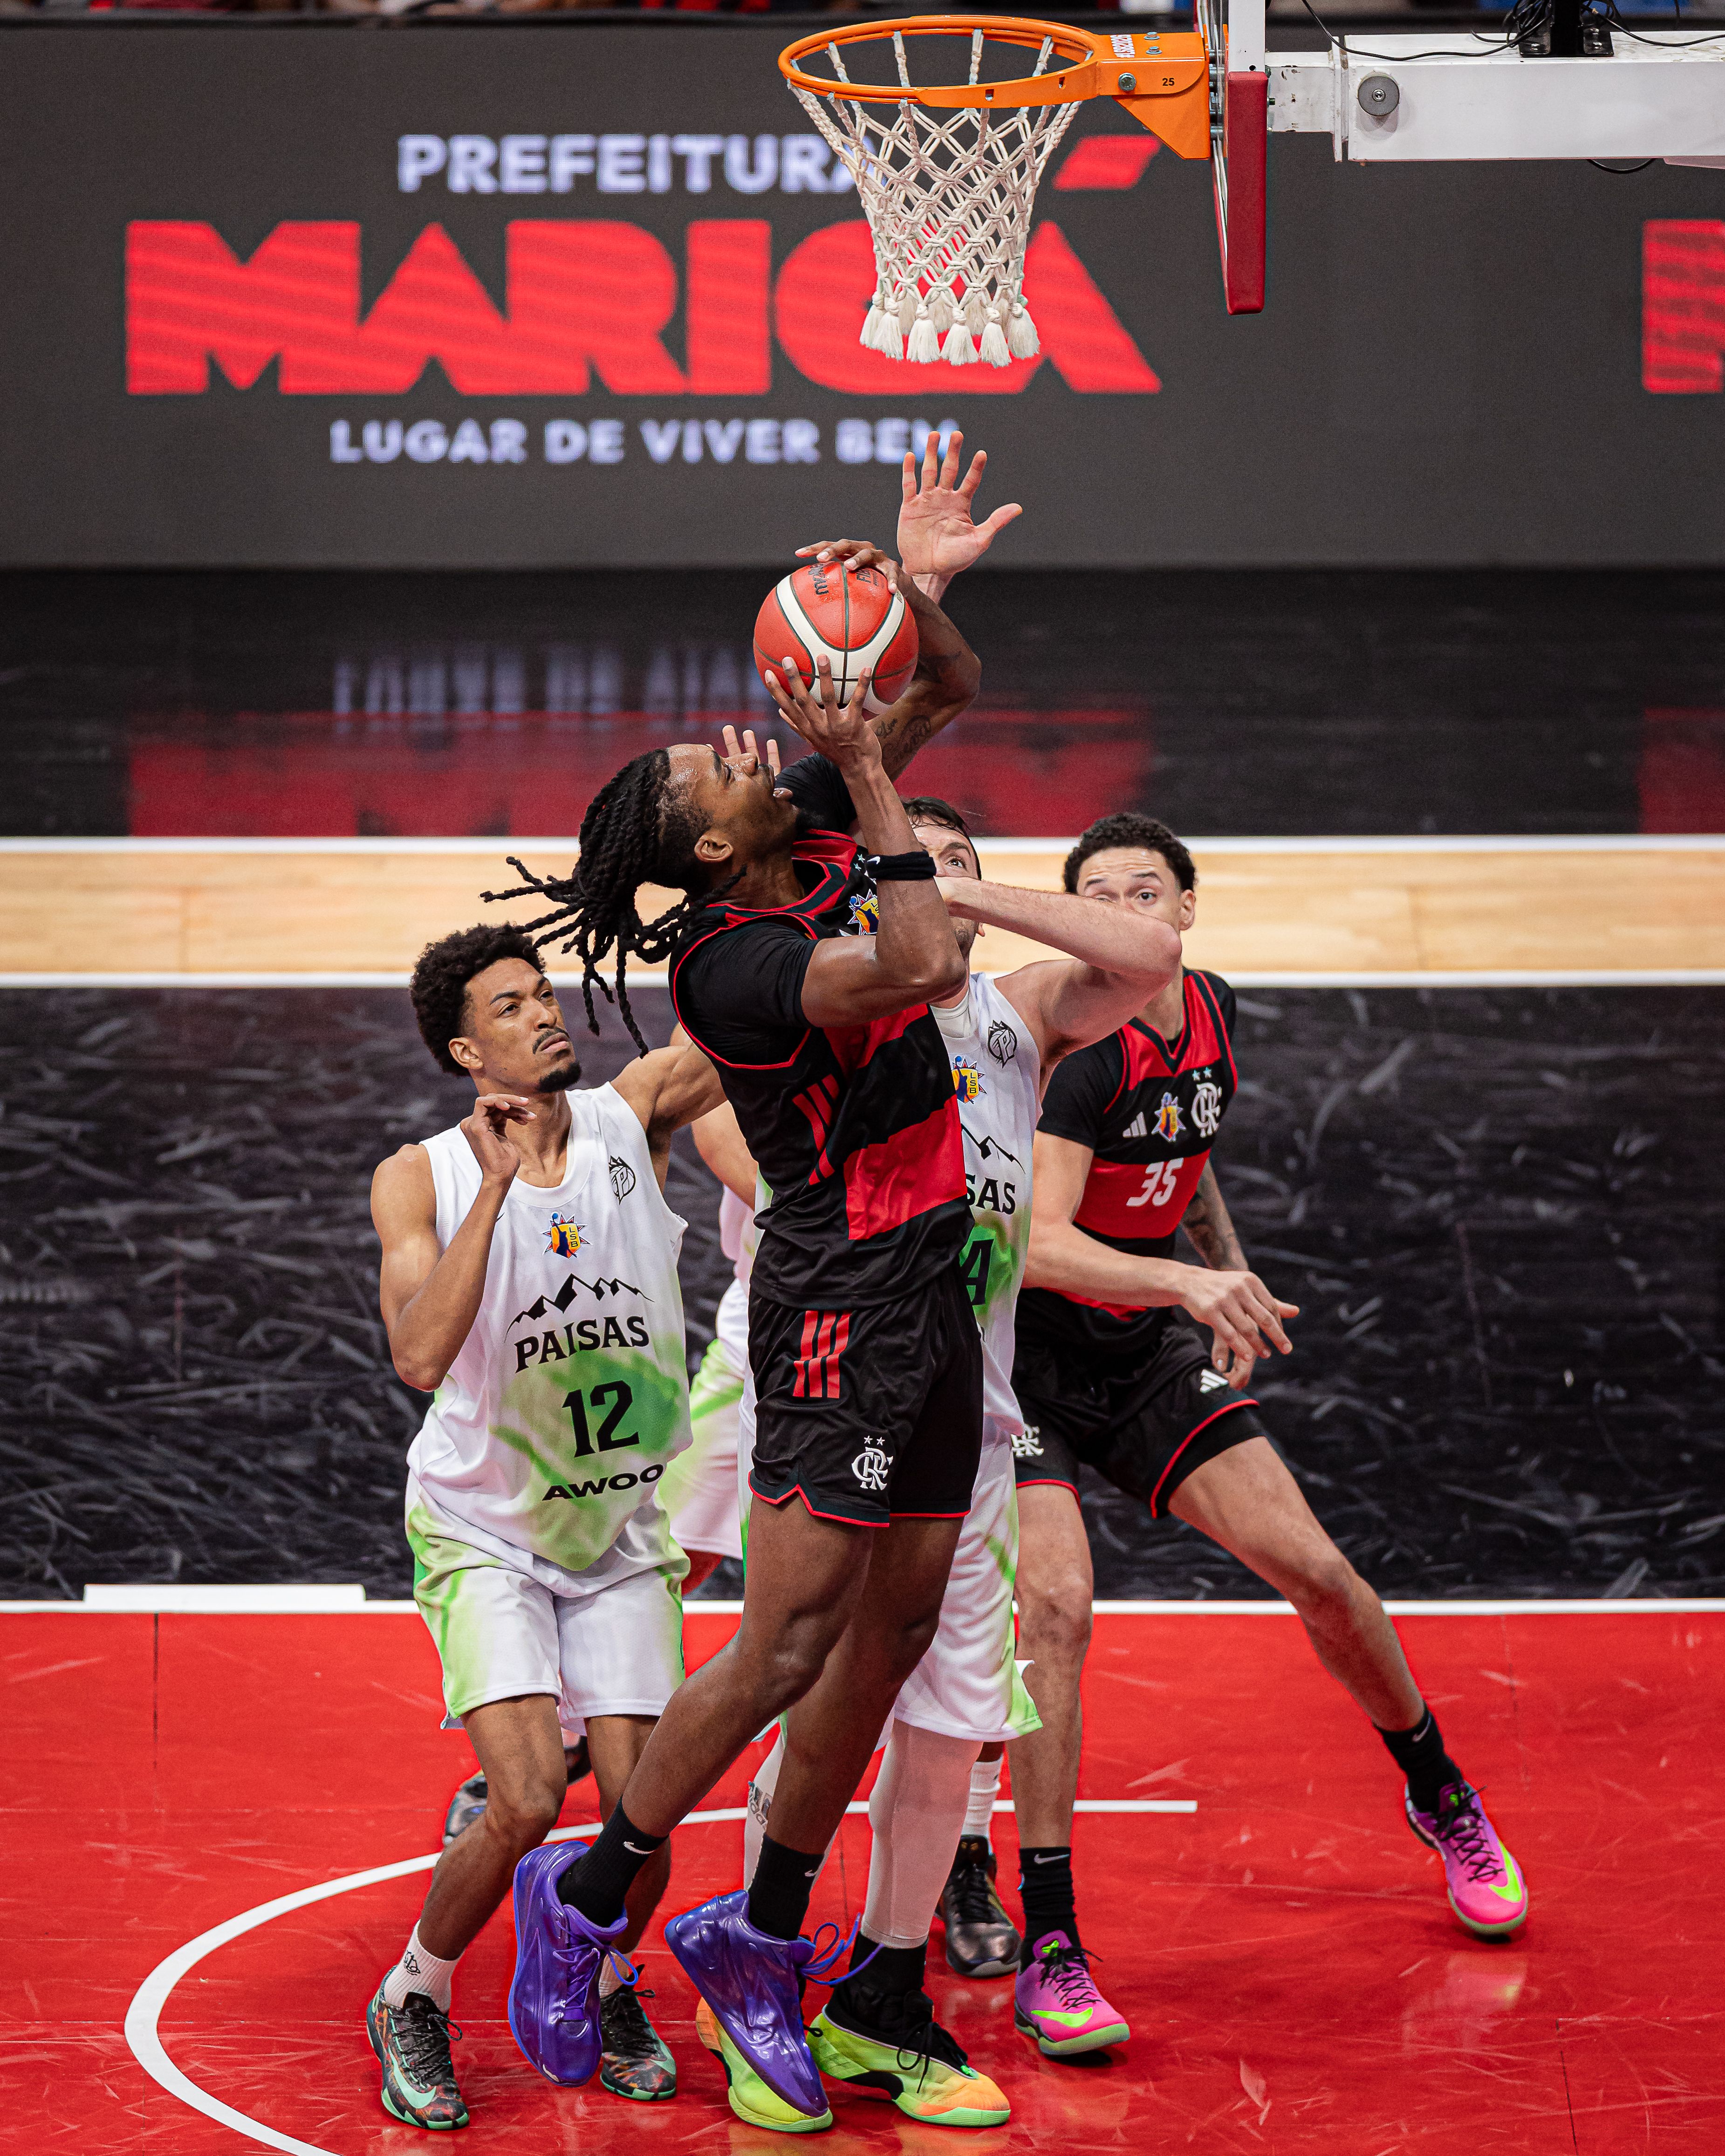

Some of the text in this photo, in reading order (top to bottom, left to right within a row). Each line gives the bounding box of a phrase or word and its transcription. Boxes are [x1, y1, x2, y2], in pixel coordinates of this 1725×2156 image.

[1162, 77, 1175, 86] 25
[329, 418, 960, 465] LUGAR DE VIVER BEM
[965, 1173, 1016, 1215] SAS
[1126, 1157, 1184, 1206] 35
[568, 1227, 578, 1247] LSB
[514, 1315, 650, 1374] PAISAS
[561, 1380, 640, 1458] 12
[542, 1464, 664, 1501] AWOO
